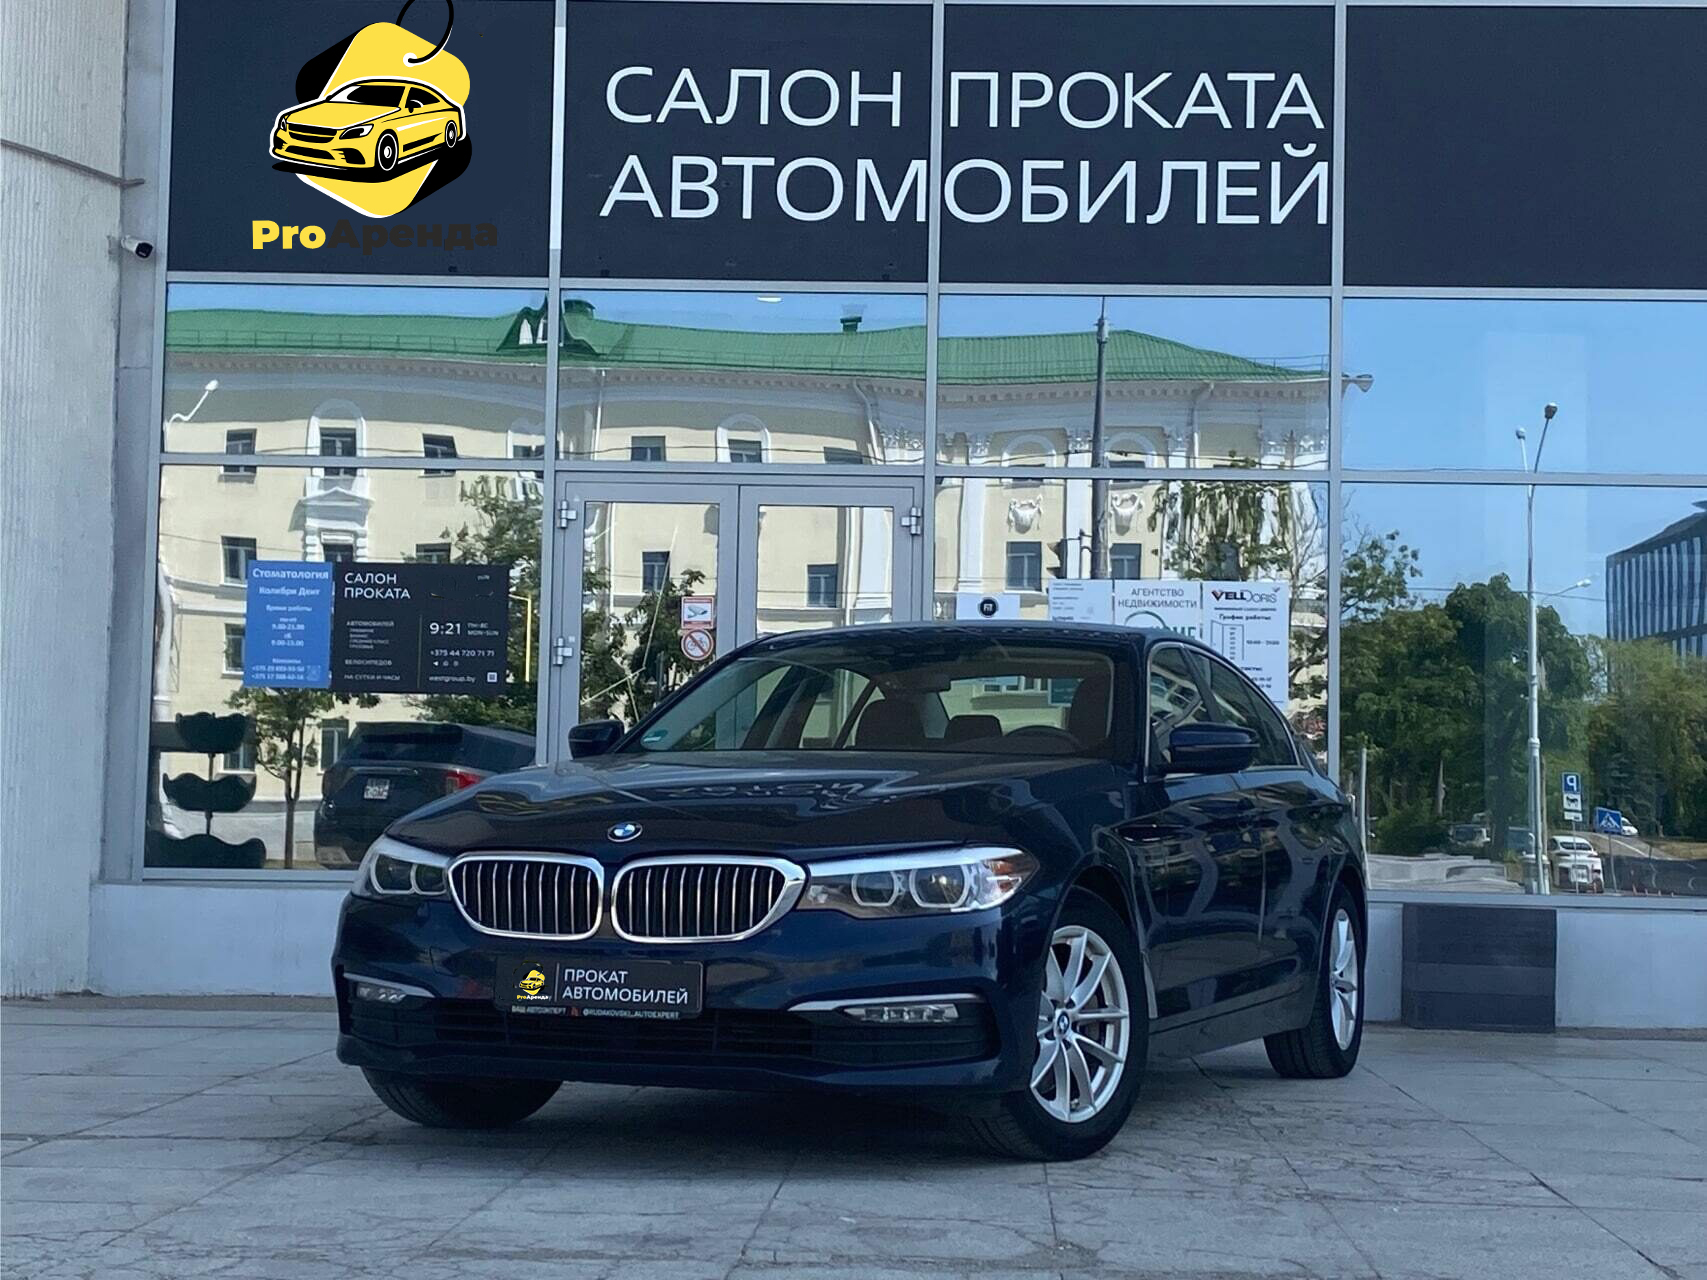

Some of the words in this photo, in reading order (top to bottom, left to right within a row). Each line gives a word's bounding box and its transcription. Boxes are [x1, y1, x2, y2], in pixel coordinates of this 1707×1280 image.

[606, 66, 902, 127] САЛОН
[949, 71, 1325, 129] ПРОКАТА
[599, 143, 1329, 225] АВТОМОБИЛЕЙ
[252, 568, 329, 579] Стоматология
[344, 572, 397, 584] САЛОН
[344, 587, 411, 599] ПРОКАТА
[1131, 588, 1185, 597] АГЕНТСТВО
[1118, 599, 1198, 609] НЕДВИЖИМОСТИ
[429, 622, 461, 635] 9:21
[430, 649, 448, 657] +375
[564, 968, 629, 984] ПРОКАТ
[562, 986, 689, 1005] АВТОМОБИЛЕЙ
